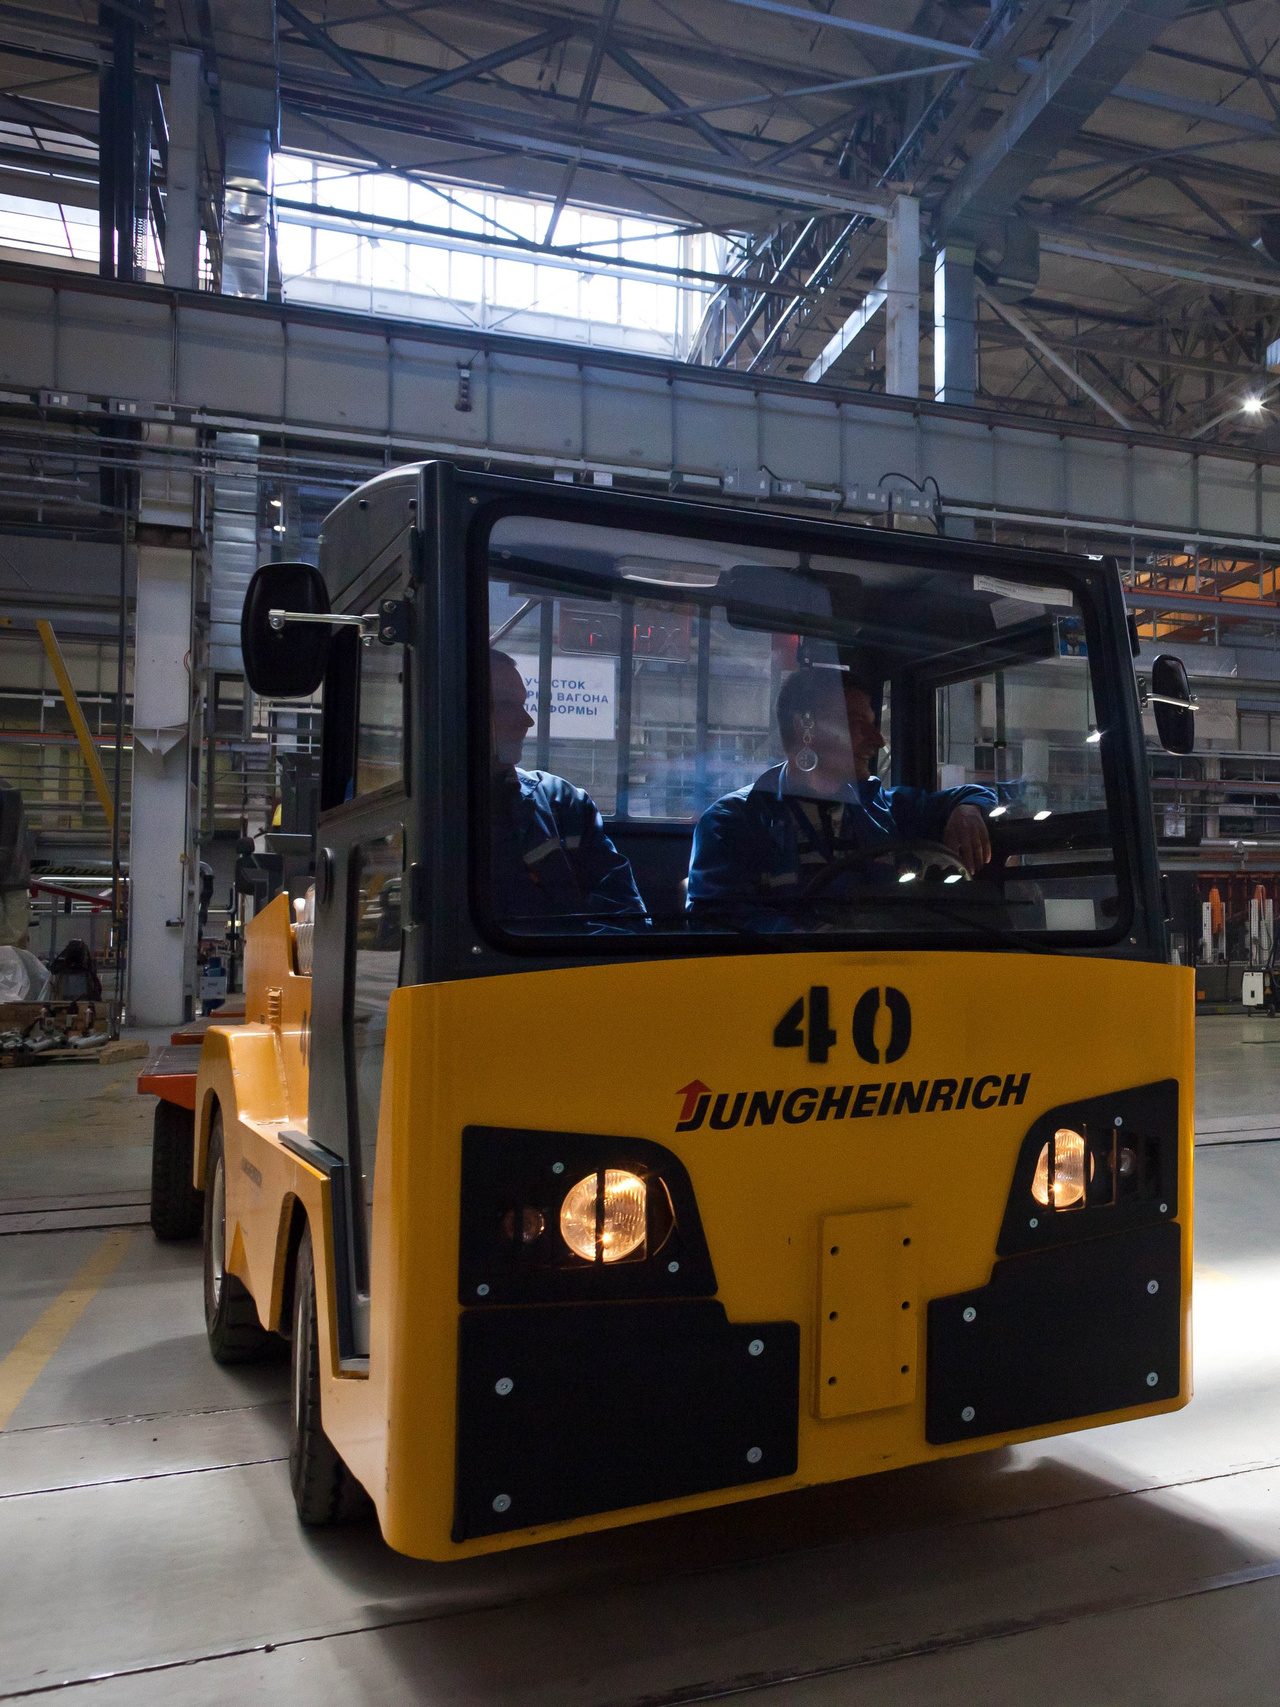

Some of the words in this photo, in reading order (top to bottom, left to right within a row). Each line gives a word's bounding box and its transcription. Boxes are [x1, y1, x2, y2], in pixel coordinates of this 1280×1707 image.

[525, 677, 586, 690] УЧСТОК
[557, 692, 609, 704] ВАГОНА
[772, 985, 912, 1065] 40
[675, 1073, 1031, 1132] JUNGHEINRICH
